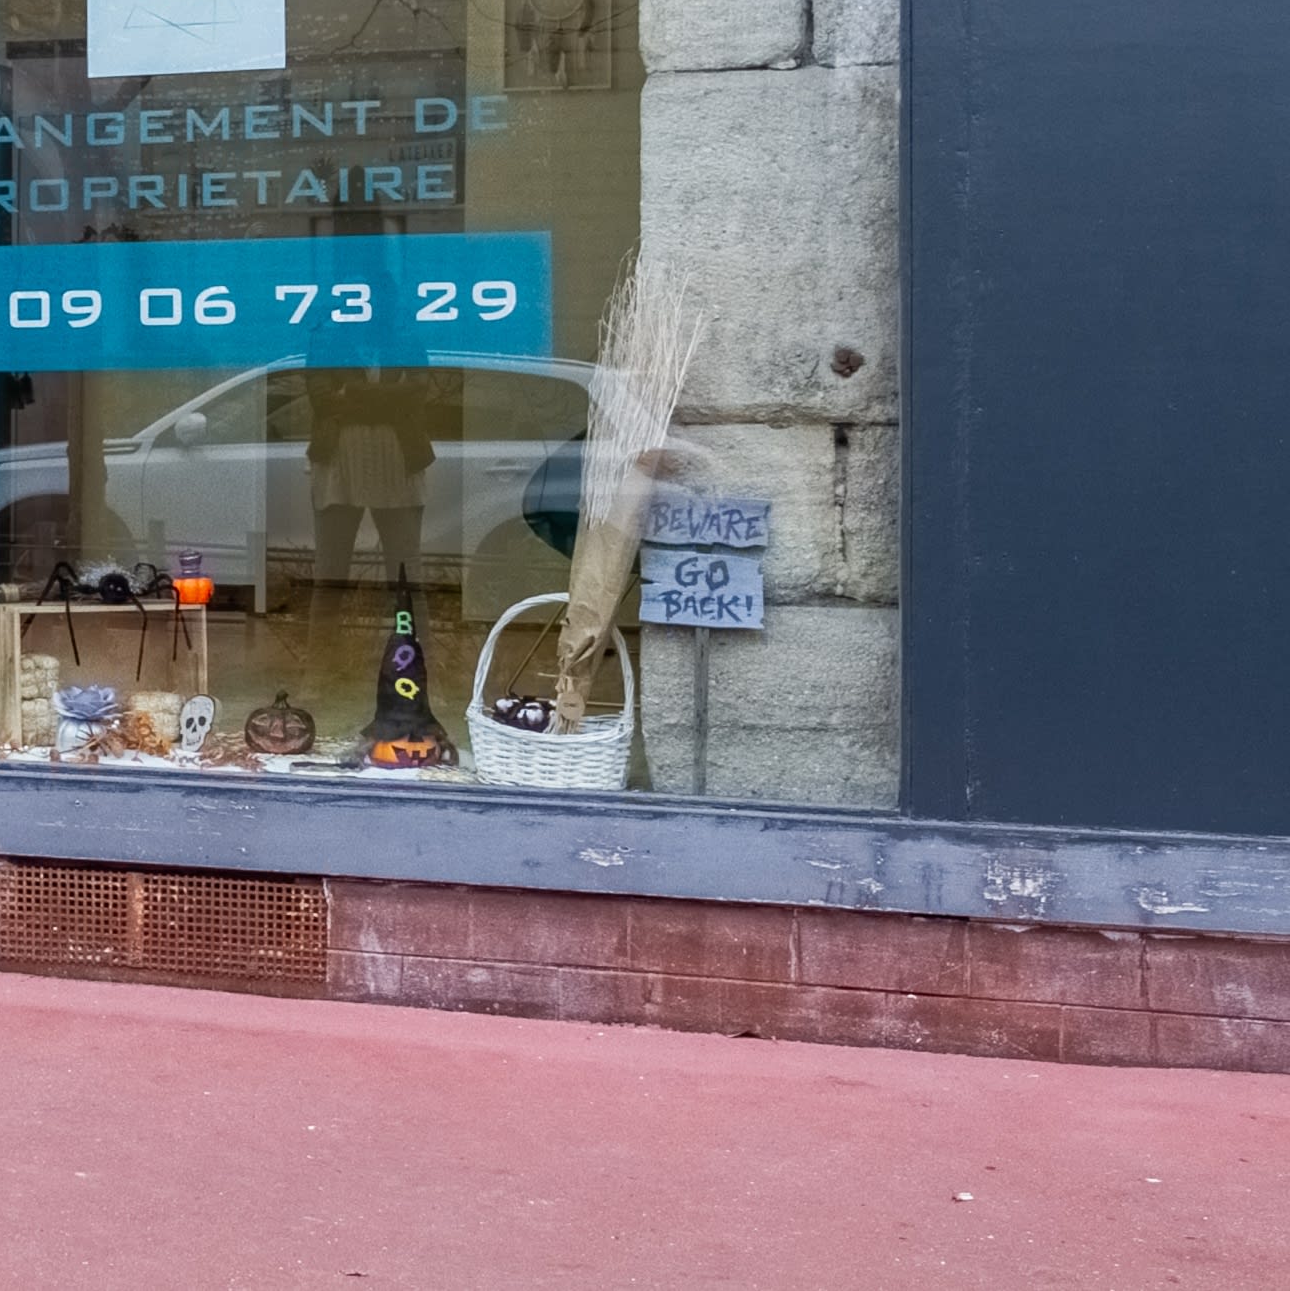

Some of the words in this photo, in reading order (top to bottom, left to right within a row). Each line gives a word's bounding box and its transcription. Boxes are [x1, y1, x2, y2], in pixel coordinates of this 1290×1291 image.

[414, 94, 509, 133] DE
[9, 289, 101, 329] 09
[139, 286, 237, 326] 06
[275, 284, 373, 324] 73
[416, 280, 518, 321] 29
[675, 557, 730, 591] GO
[660, 590, 753, 622] BACK!
